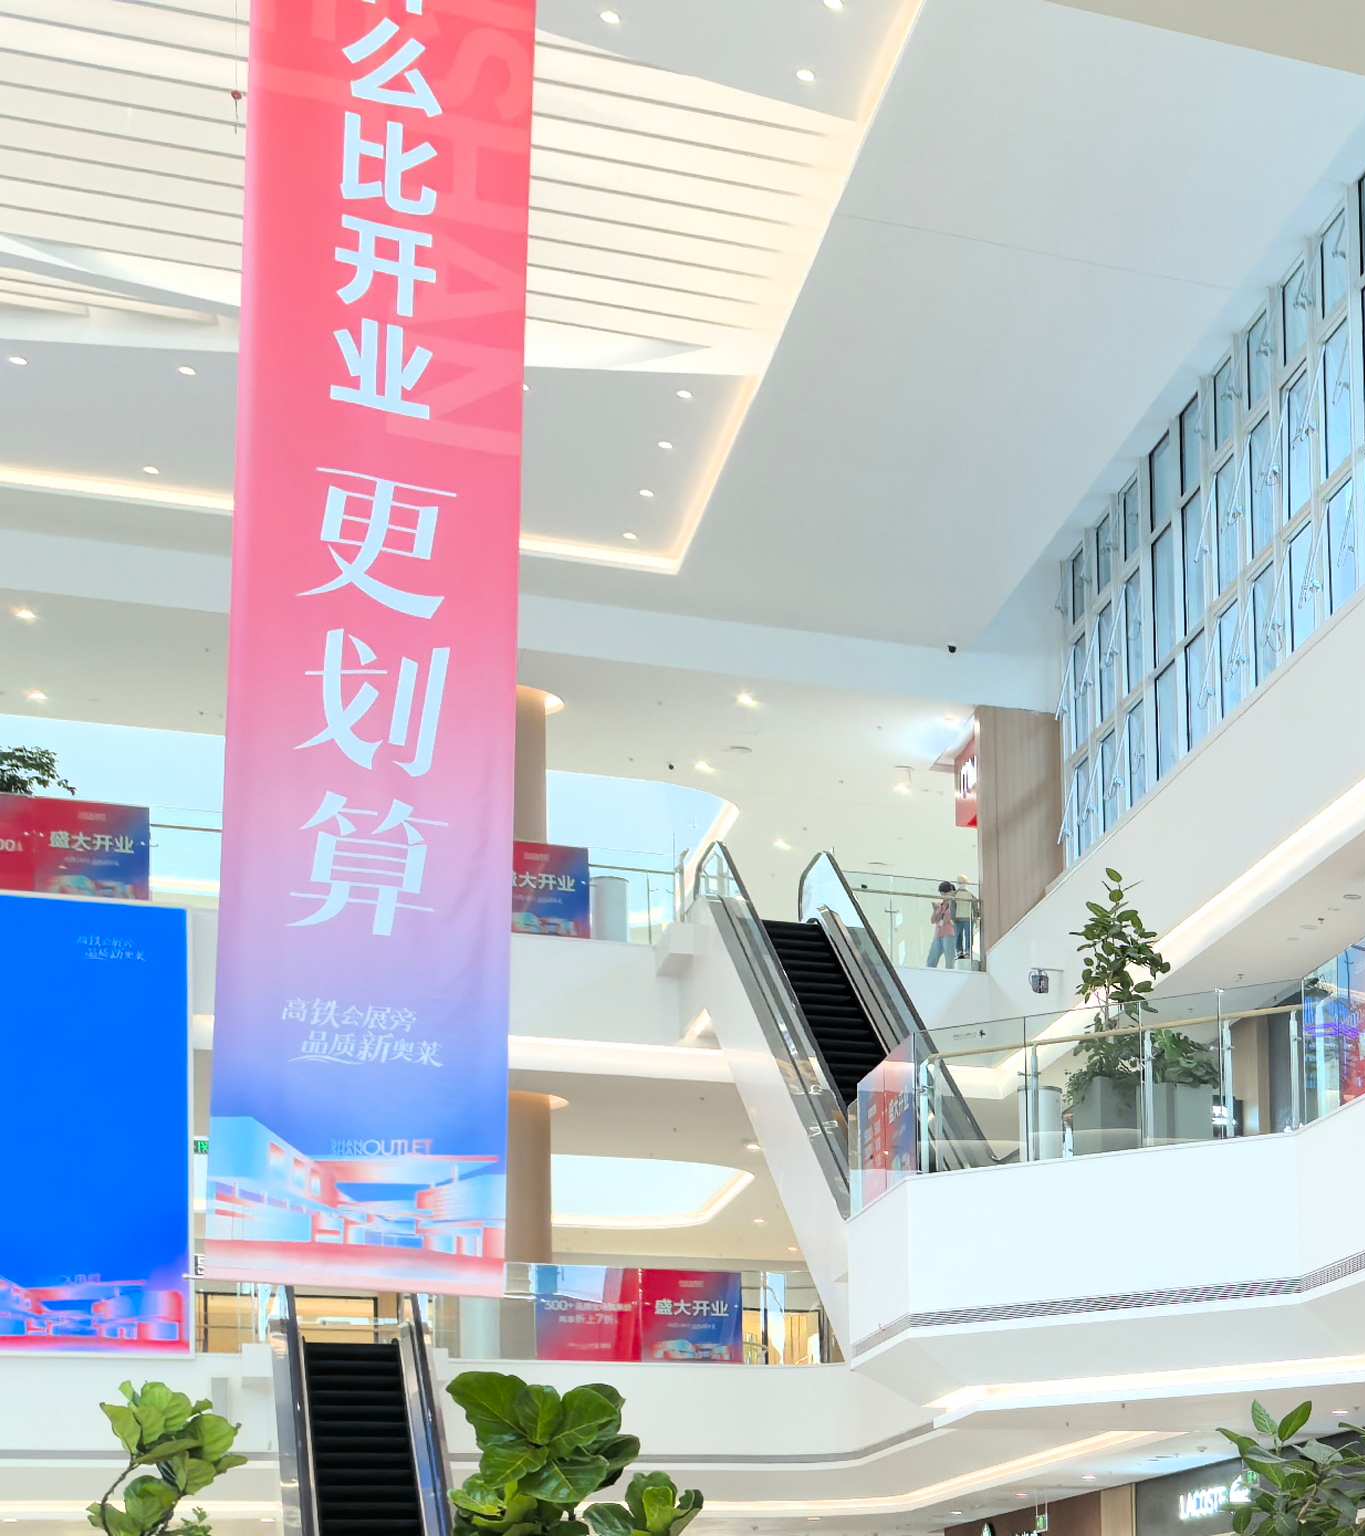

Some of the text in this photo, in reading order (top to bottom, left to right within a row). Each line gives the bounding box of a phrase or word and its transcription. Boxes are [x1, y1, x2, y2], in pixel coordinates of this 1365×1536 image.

[287, 0, 457, 938] 么比开业 更划算
[50, 830, 135, 854] 盛大开业
[282, 997, 417, 1032] 高铁会展旁
[301, 1029, 444, 1069] 品质新奥莱
[654, 1298, 729, 1317] 盛大开业
